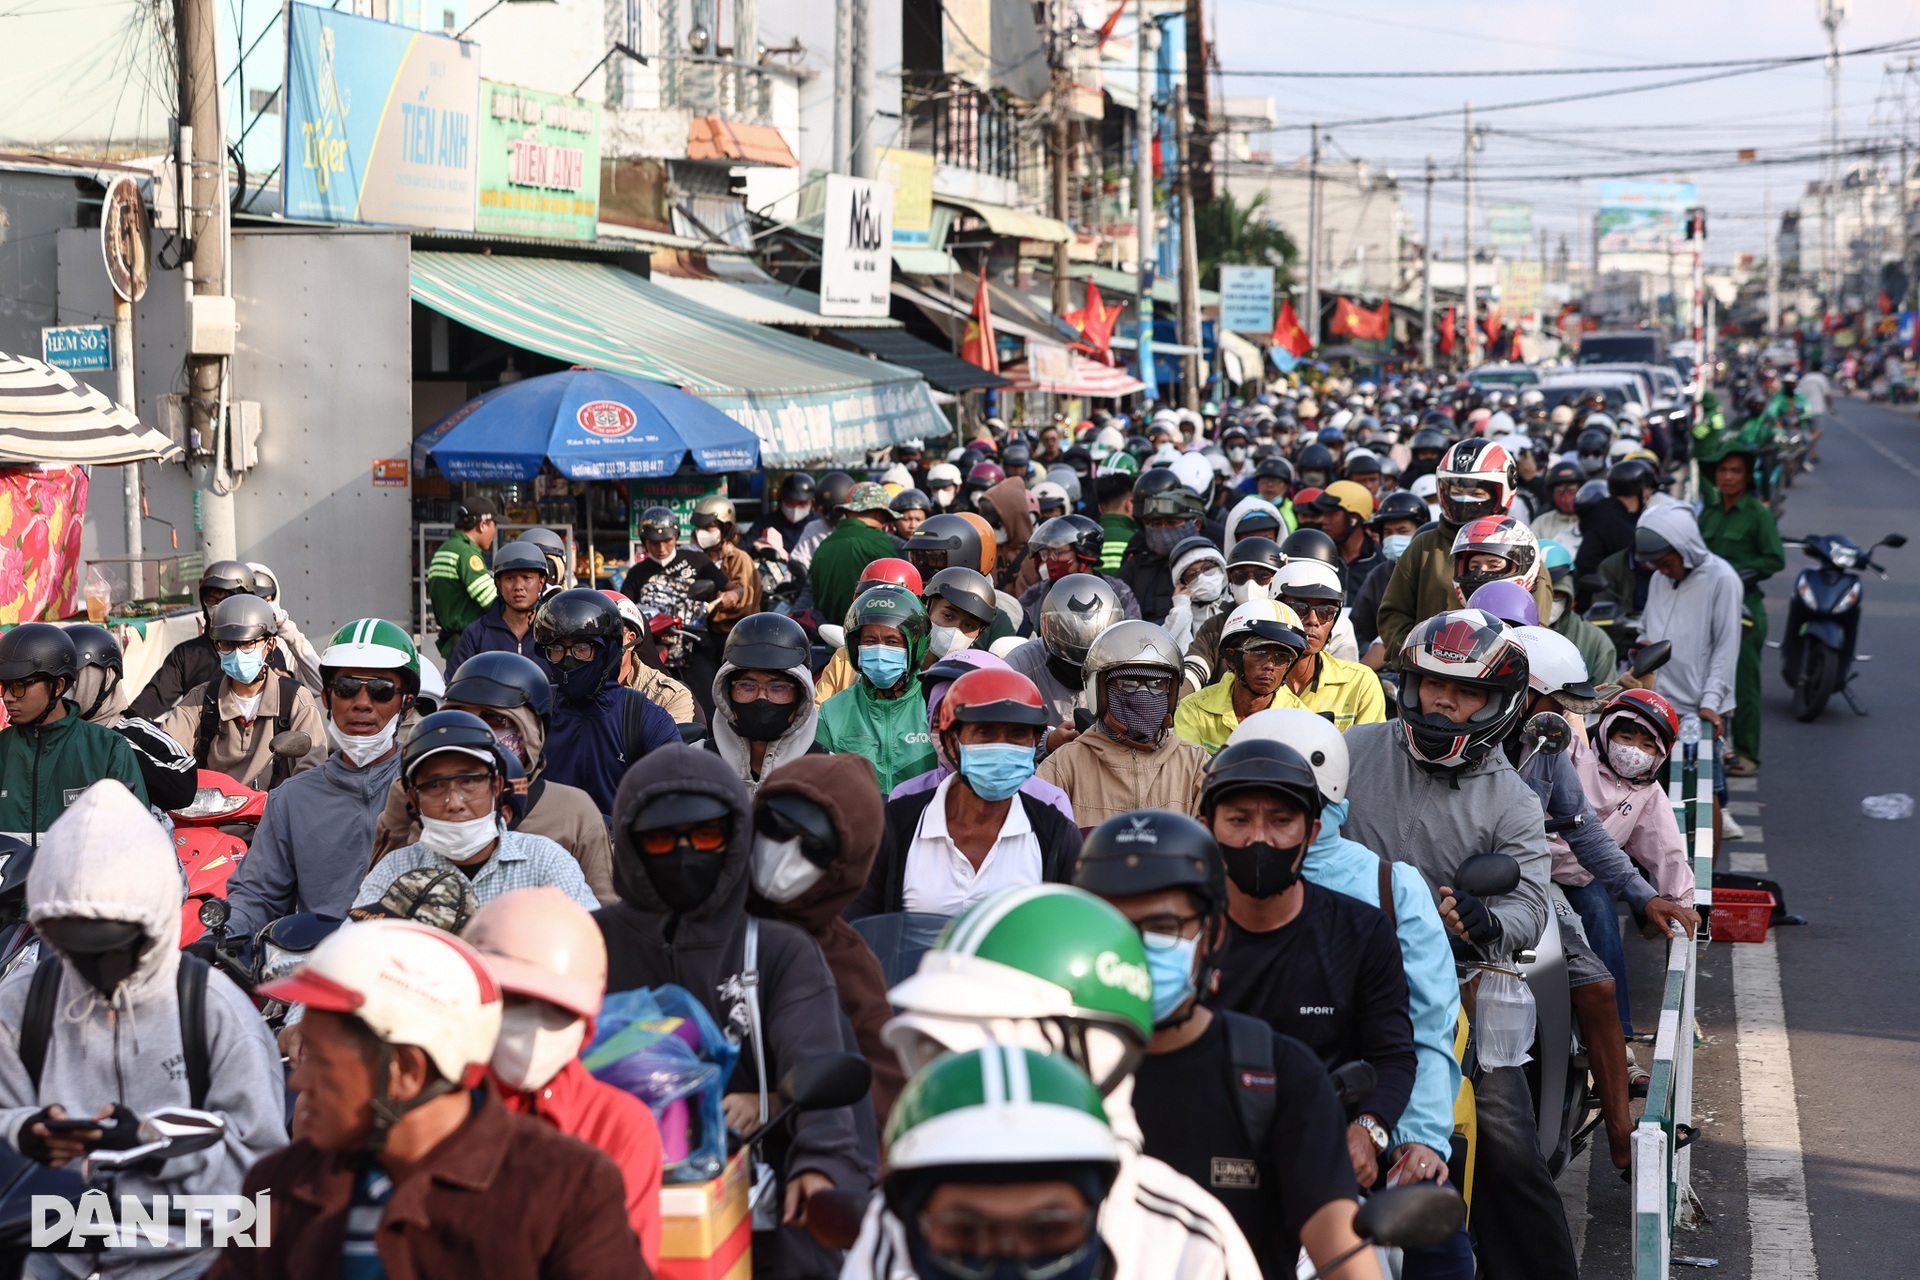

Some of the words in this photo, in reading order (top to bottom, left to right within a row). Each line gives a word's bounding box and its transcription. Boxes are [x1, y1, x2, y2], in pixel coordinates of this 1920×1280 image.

[402, 85, 435, 165] TIẾN
[438, 109, 469, 170] ANH
[302, 118, 348, 193] Tiger
[515, 127, 548, 183] TIẾN
[552, 147, 583, 188] ANH
[80, 331, 98, 350] SỐ
[866, 599, 896, 609] Grab
[1299, 1006, 1335, 1015] SPORT
